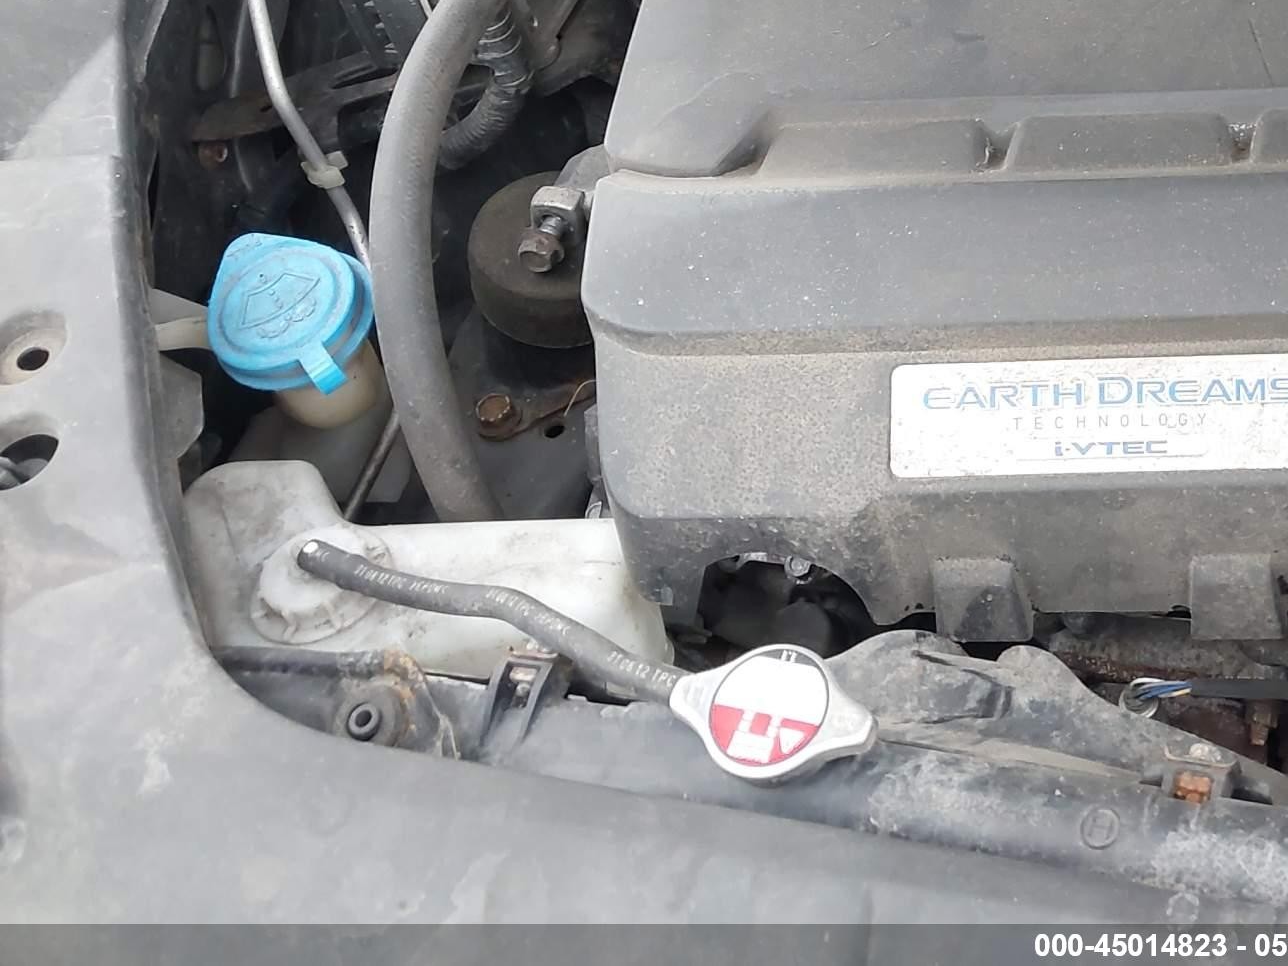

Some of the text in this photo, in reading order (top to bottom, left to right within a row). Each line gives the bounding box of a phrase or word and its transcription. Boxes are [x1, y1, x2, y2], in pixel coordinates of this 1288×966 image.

[922, 381, 1084, 411] EARTH
[1012, 412, 1208, 432] TECHNOLOGY
[1053, 438, 1169, 458] i-VTEC
